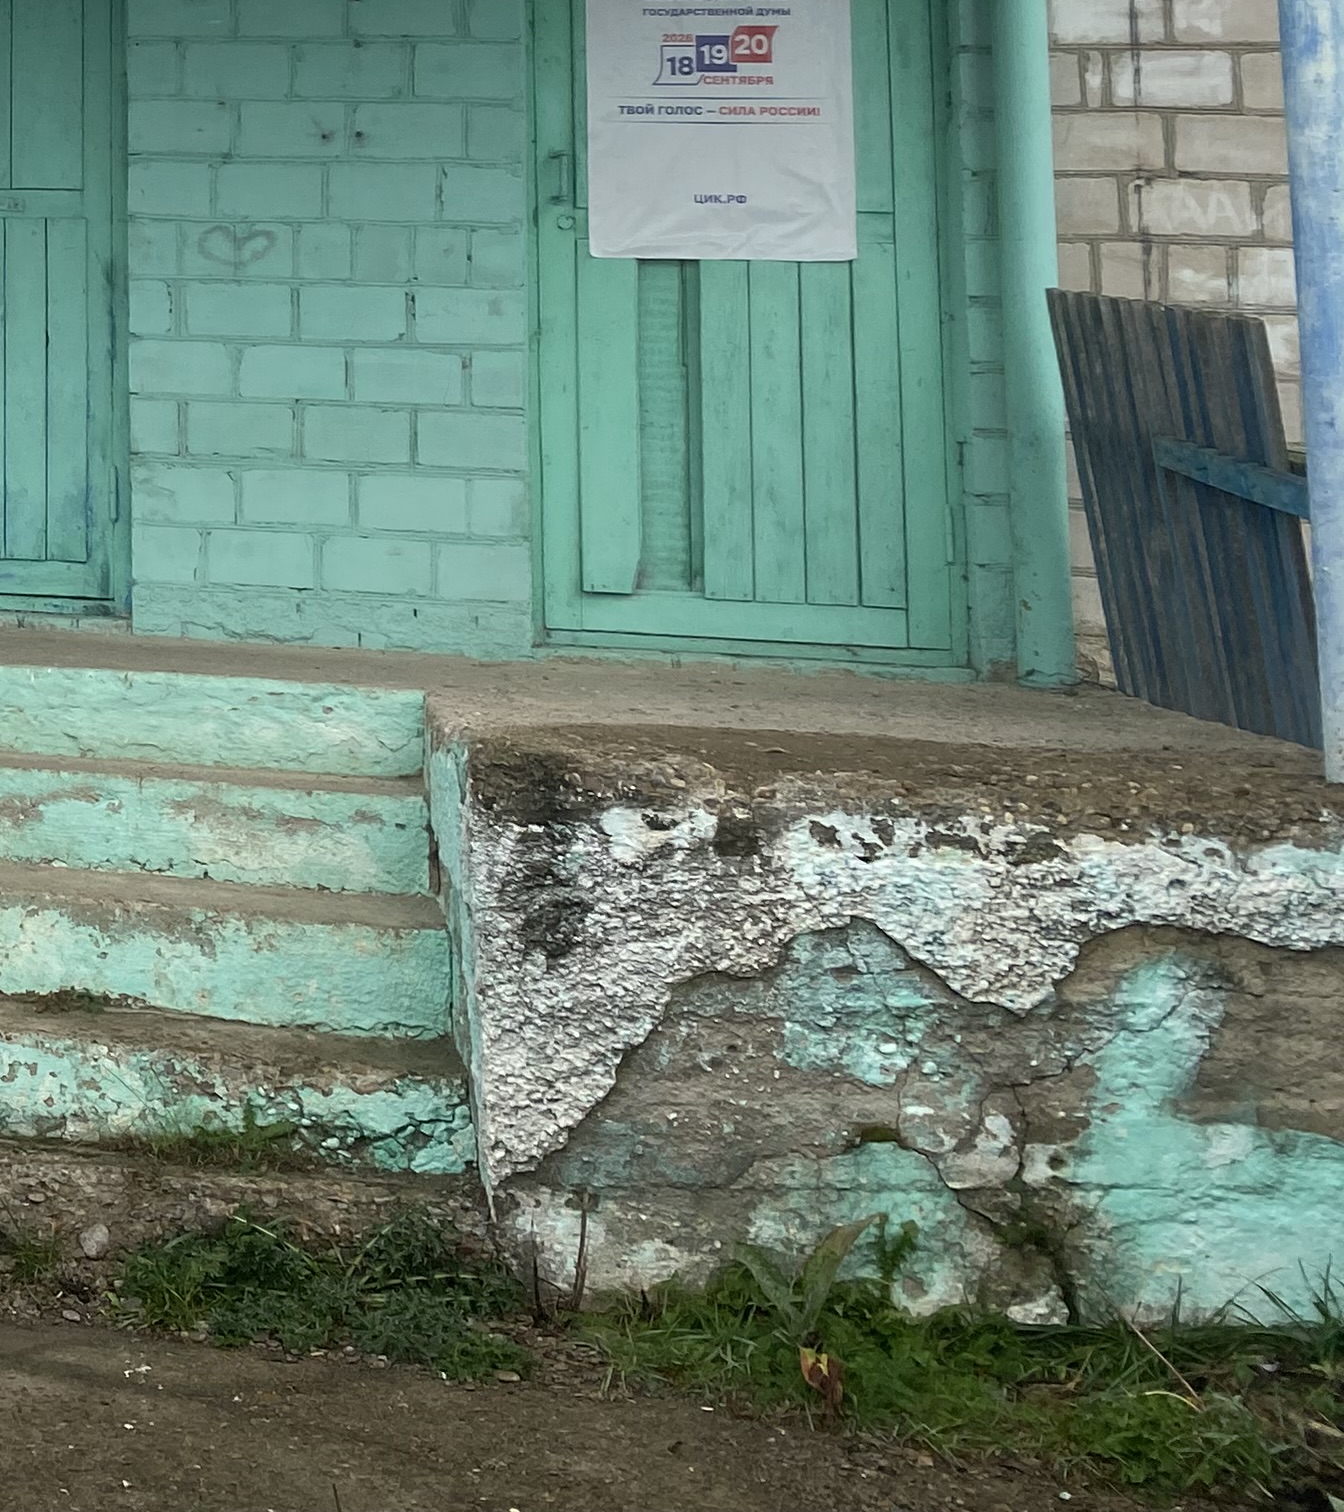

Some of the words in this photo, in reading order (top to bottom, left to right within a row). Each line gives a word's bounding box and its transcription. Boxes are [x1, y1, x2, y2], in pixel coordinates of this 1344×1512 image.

[642, 6, 753, 17] ГОСУДАРСТВЕННОЙ
[755, 7, 791, 17] ДУМЫ
[662, 33, 693, 43] 2026
[666, 56, 694, 76] 18
[699, 44, 729, 65] 19
[734, 34, 769, 55] 20
[703, 75, 774, 86] СЕНТЯБРЯ
[618, 103, 655, 116] ТВОЙ
[657, 105, 703, 116] ГОЛОС
[718, 105, 756, 116] СИЛА
[759, 106, 821, 117] РОССИИ!
[693, 193, 748, 205] ЦИК.РФ
